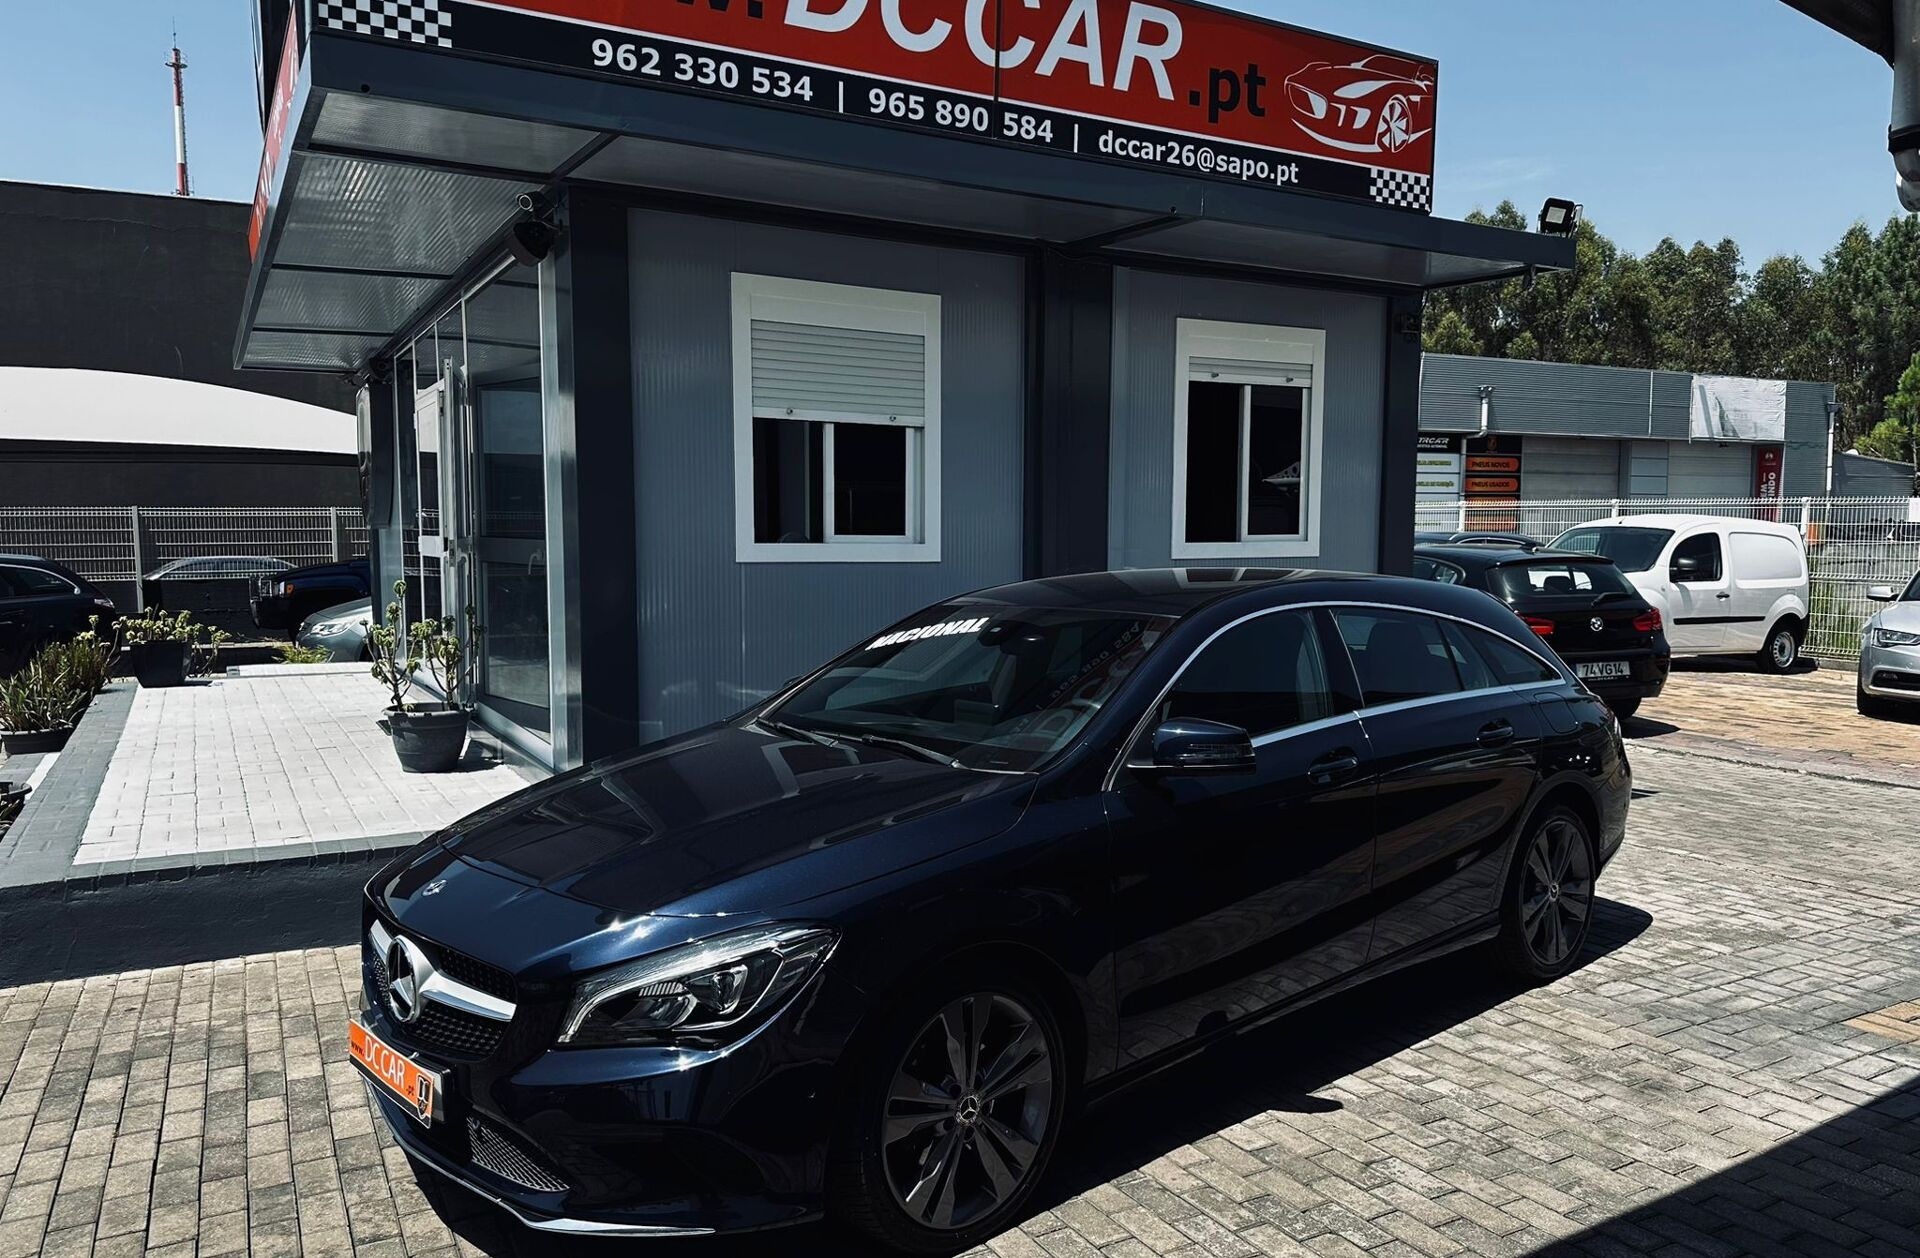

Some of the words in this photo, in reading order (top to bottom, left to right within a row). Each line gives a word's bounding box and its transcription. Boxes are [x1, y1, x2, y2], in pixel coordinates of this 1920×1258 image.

[591, 38, 661, 76] 962
[674, 53, 739, 89] 330
[752, 66, 813, 101] 534
[868, 88, 925, 120] 965
[935, 100, 989, 132] 890
[1003, 112, 1054, 143] 584
[1099, 129, 1299, 186] dccar26@sapo.pt
[864, 617, 990, 651] NACIONAL
